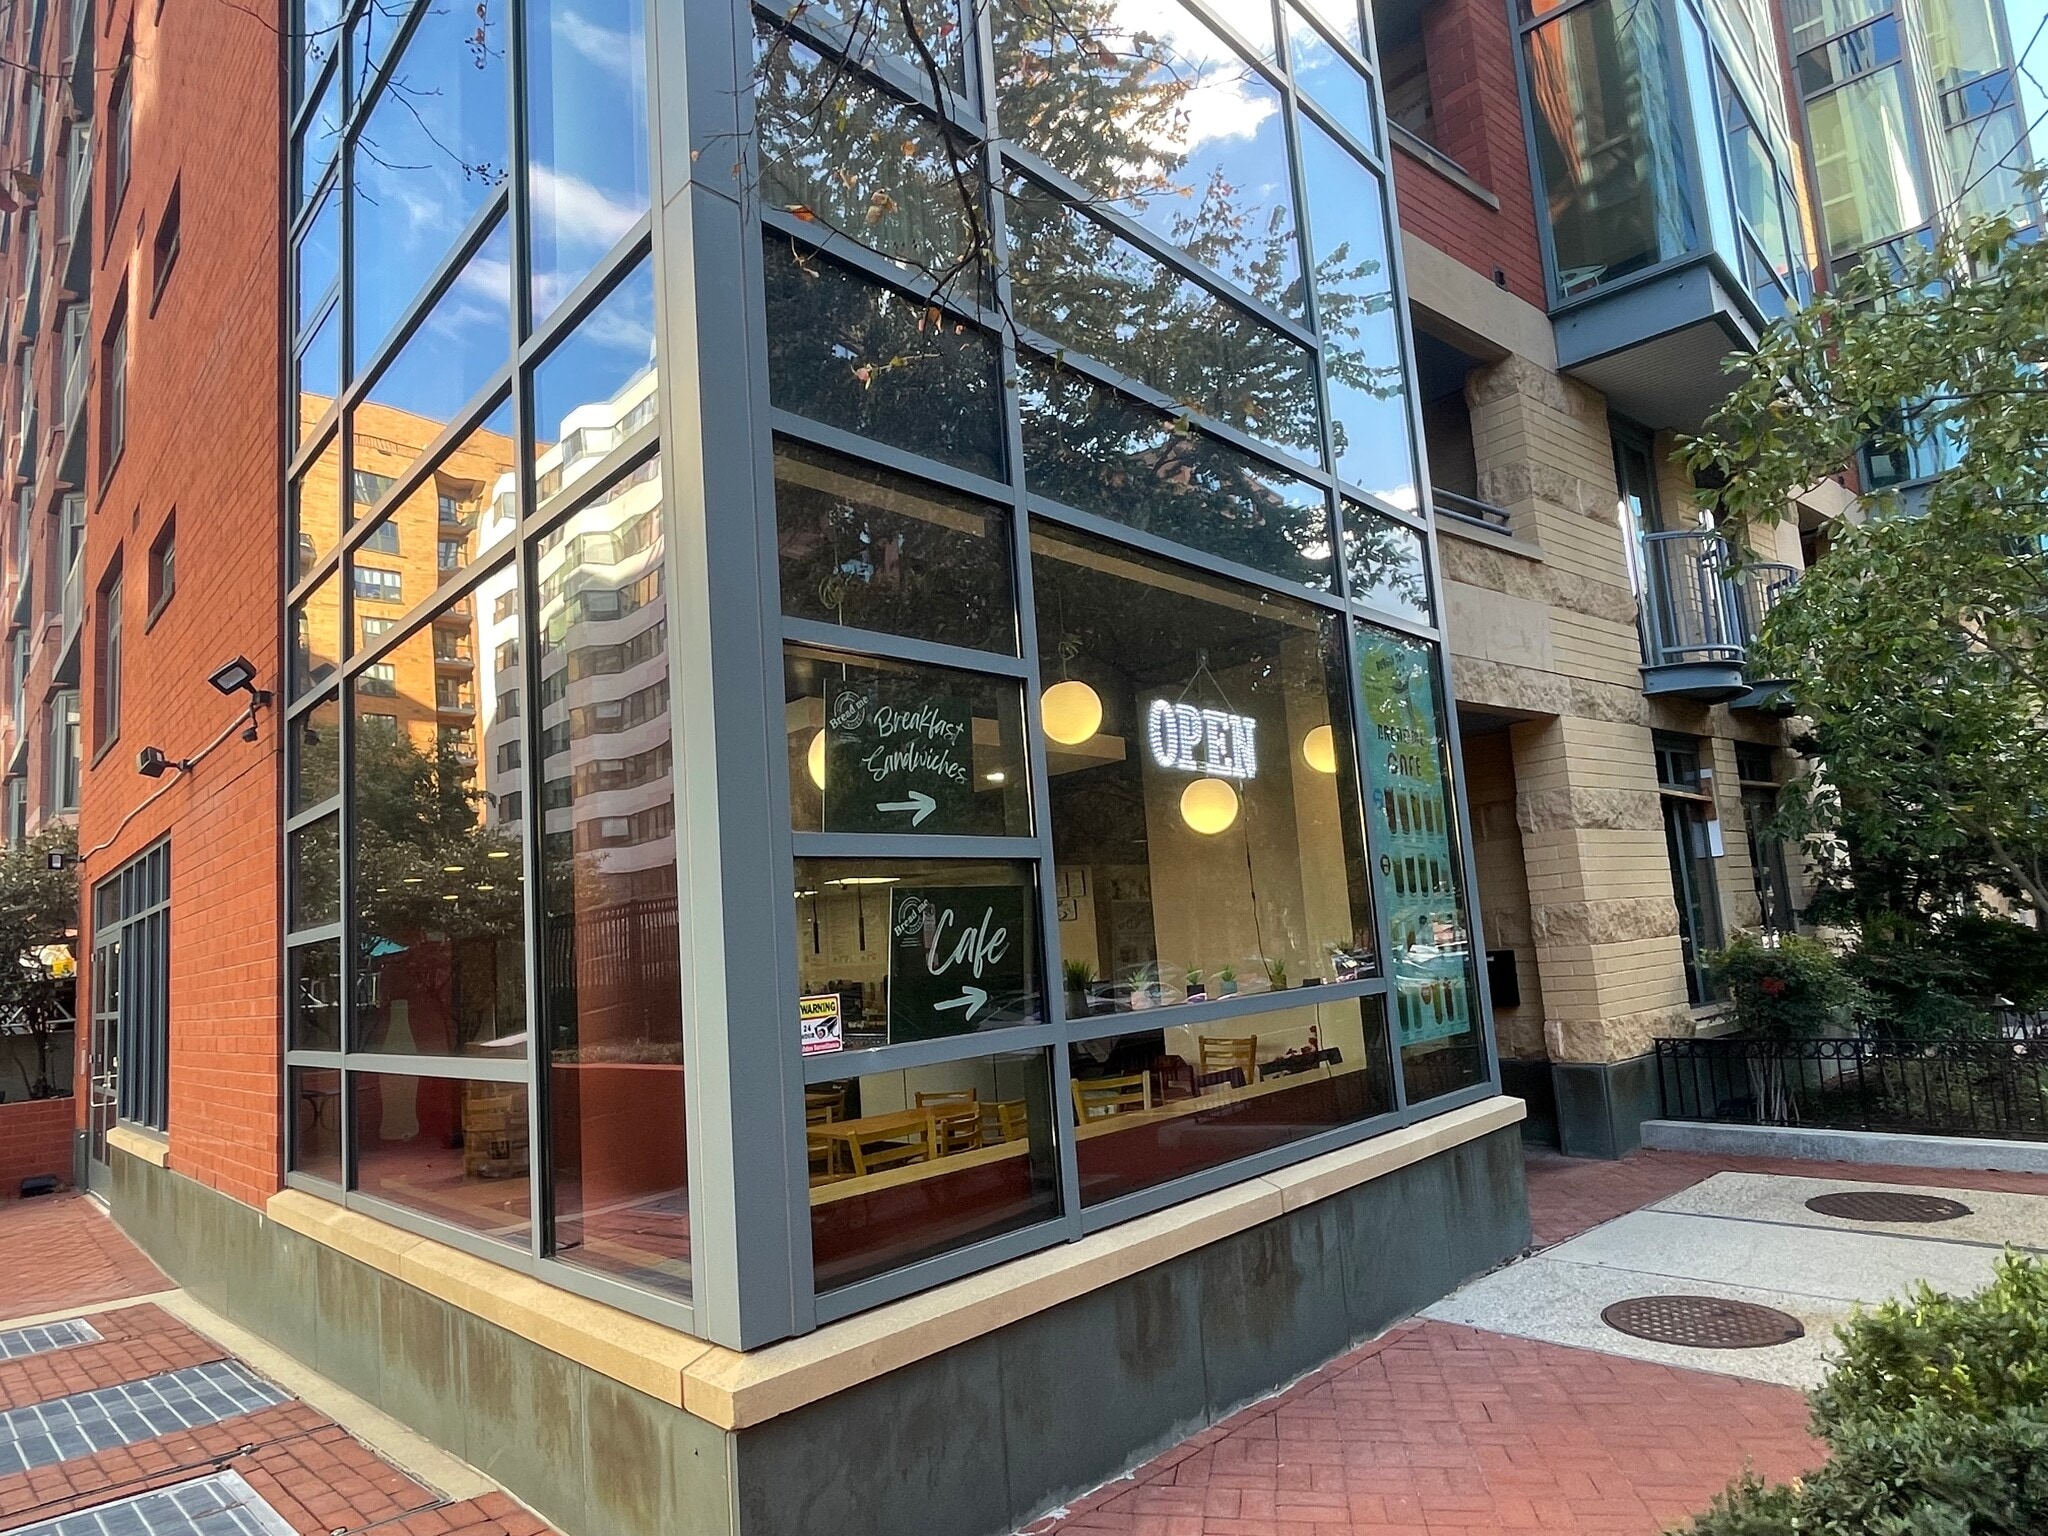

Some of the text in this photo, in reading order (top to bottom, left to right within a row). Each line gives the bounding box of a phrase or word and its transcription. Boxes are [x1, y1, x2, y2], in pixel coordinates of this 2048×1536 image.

[829, 704, 857, 730] Bread
[855, 696, 869, 710] me
[873, 705, 965, 746] Breakfast
[1149, 699, 1257, 779] OPEN
[862, 742, 968, 785] Sandwiches
[894, 909, 918, 937] Bread
[927, 906, 1010, 979] Cafe
[800, 1001, 836, 1015] WARNING
[803, 1024, 812, 1032] 24
